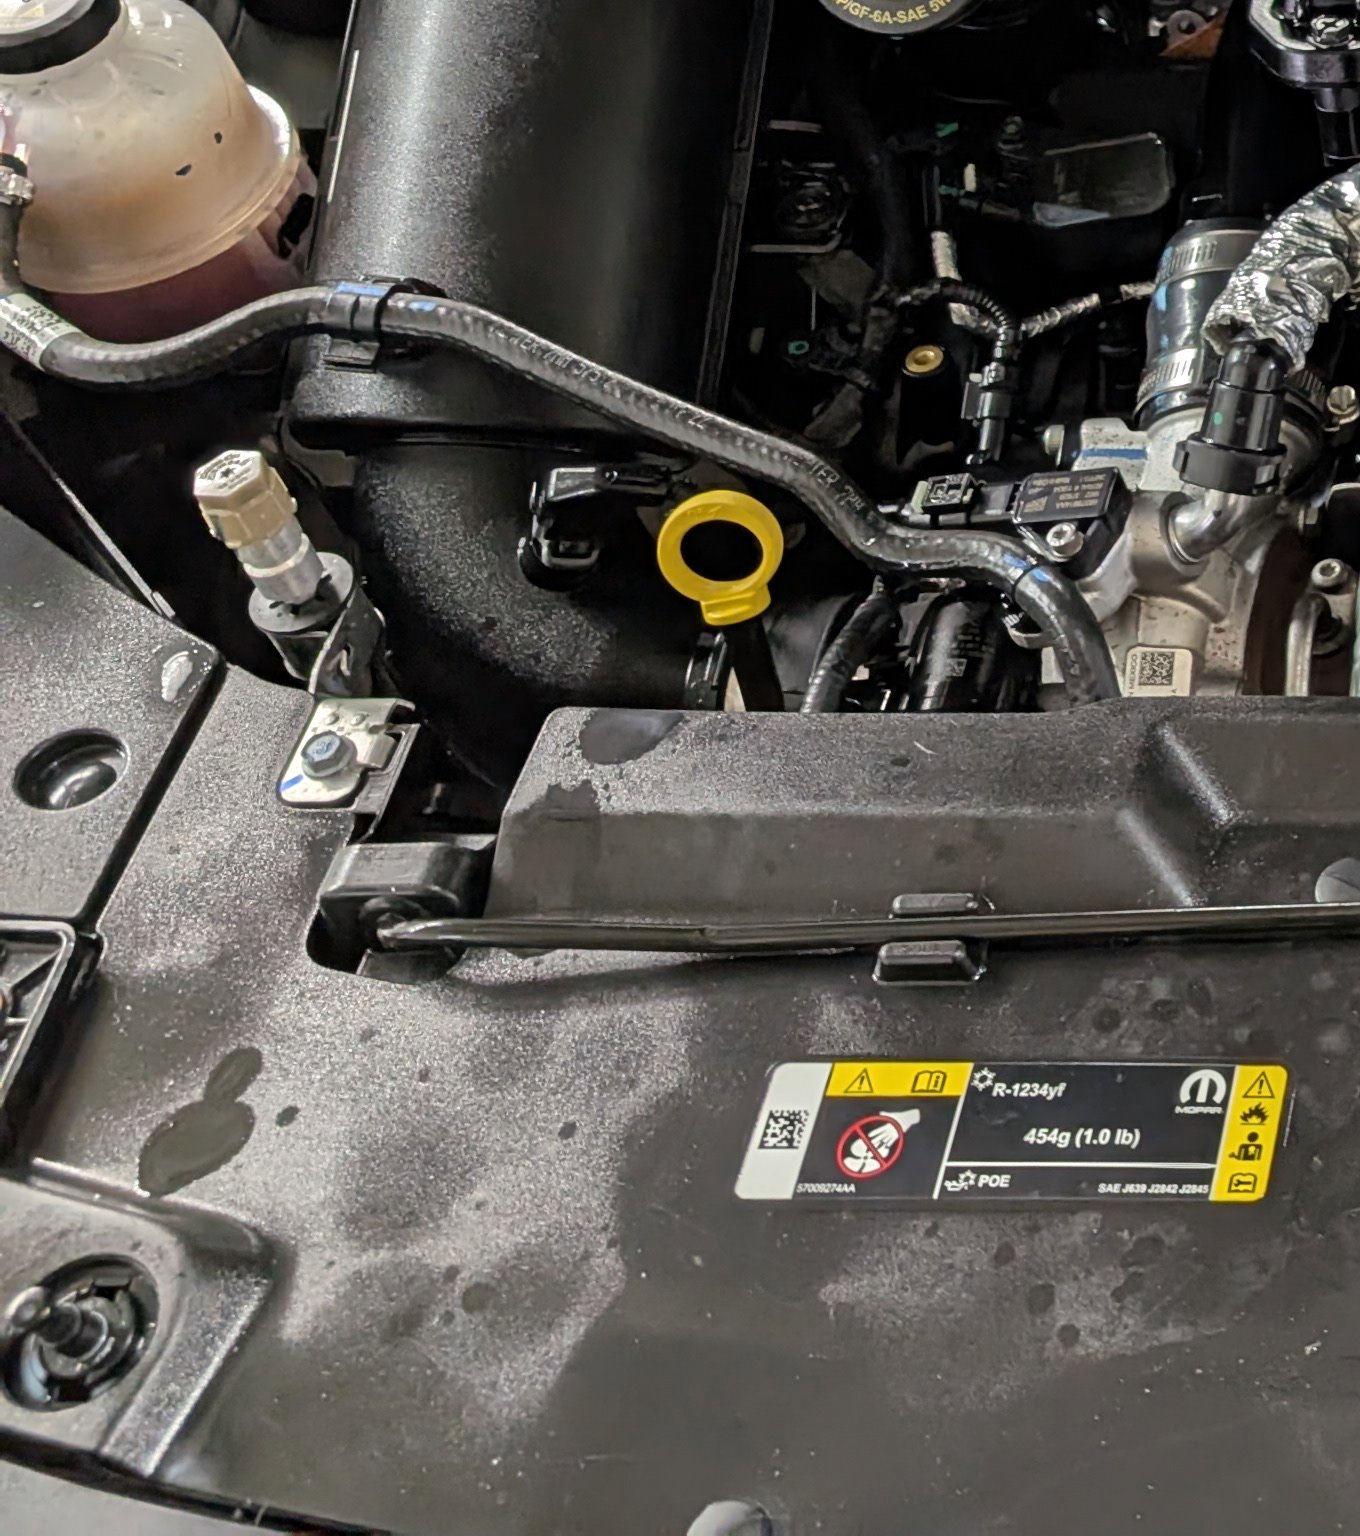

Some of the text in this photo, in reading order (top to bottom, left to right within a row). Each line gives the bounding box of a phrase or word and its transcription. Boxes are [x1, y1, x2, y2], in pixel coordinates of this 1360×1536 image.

[991, 1079, 1067, 1100] R-1234yf
[1174, 1105, 1224, 1115] MOPAR
[1022, 1126, 1142, 1150] 454g (1.0 lb)
[976, 1172, 1012, 1190] POE
[1097, 1183, 1121, 1195] SAE
[1121, 1183, 1147, 1195] J639
